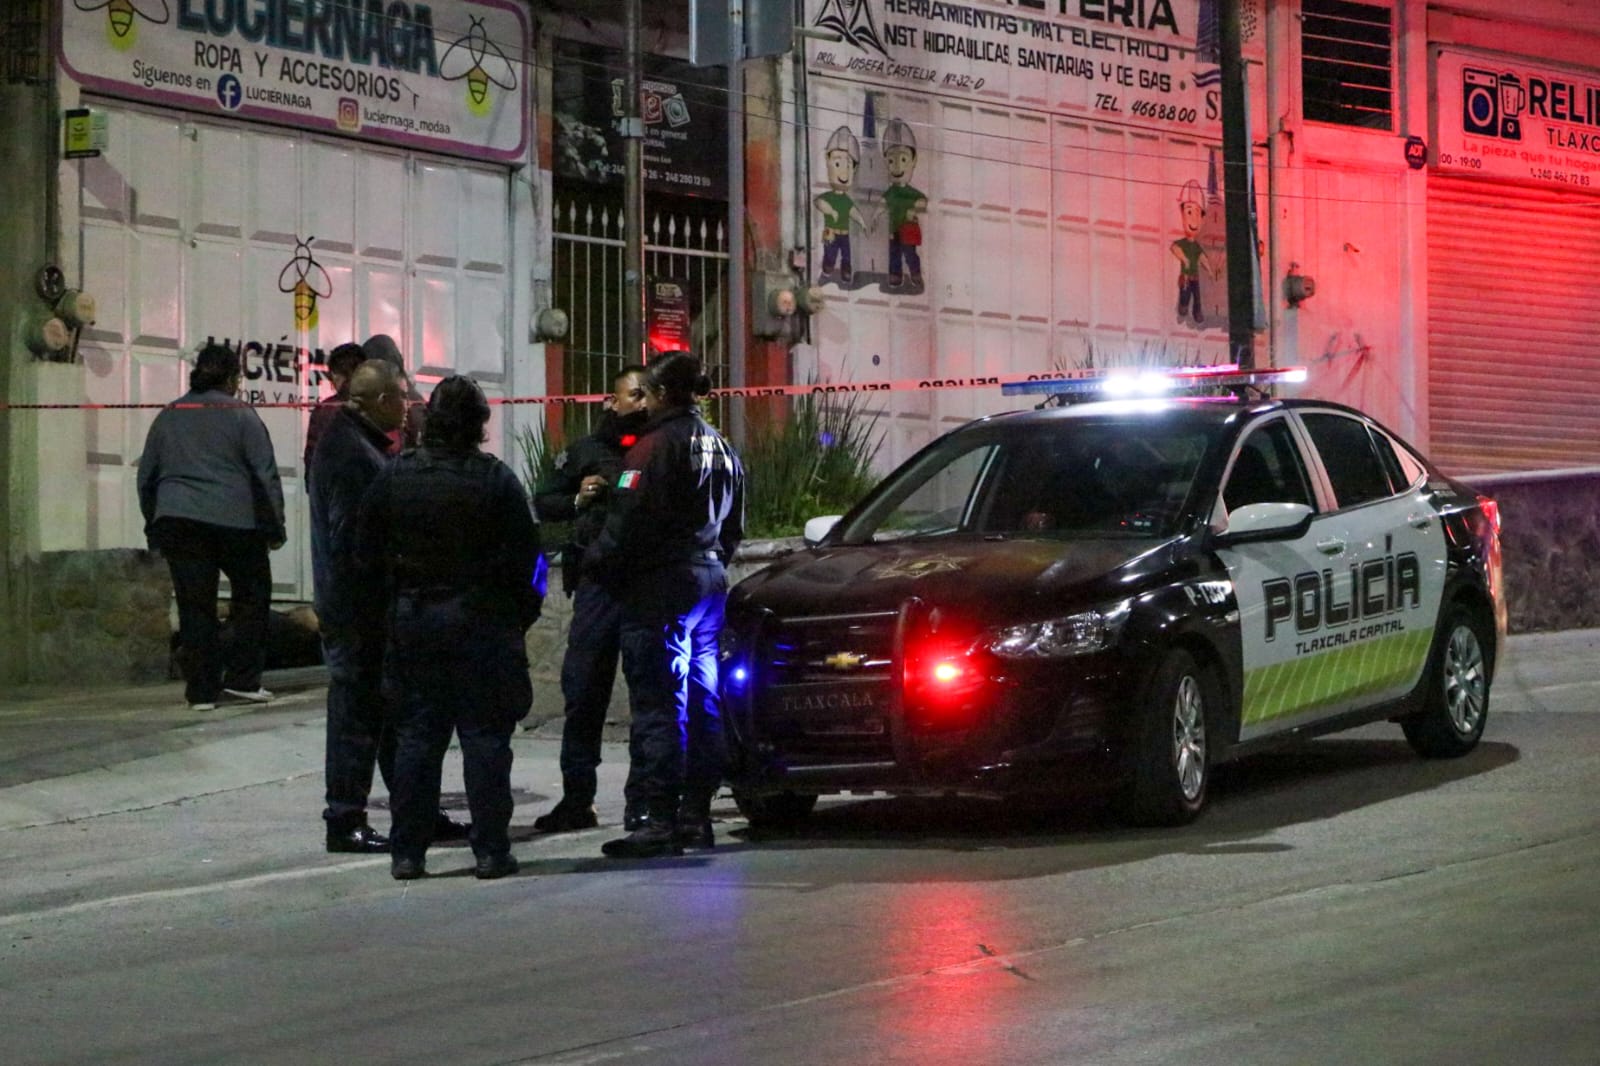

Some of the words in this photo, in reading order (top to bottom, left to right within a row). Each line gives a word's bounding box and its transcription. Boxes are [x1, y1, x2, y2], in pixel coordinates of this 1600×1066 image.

[884, 0, 1018, 34] HERRAMIENTAS
[194, 40, 243, 74] ROPA
[255, 52, 268, 77] Y
[279, 56, 400, 102] ACCESORIOS
[196, 77, 211, 91] en
[1101, 62, 1111, 82] Y
[1139, 69, 1171, 93] GAS
[1131, 100, 1197, 124] 4668800
[1296, 629, 1356, 656] TLAXCALA
[1359, 619, 1404, 641] CAPITAL
[783, 692, 873, 711] TLAXCALA
